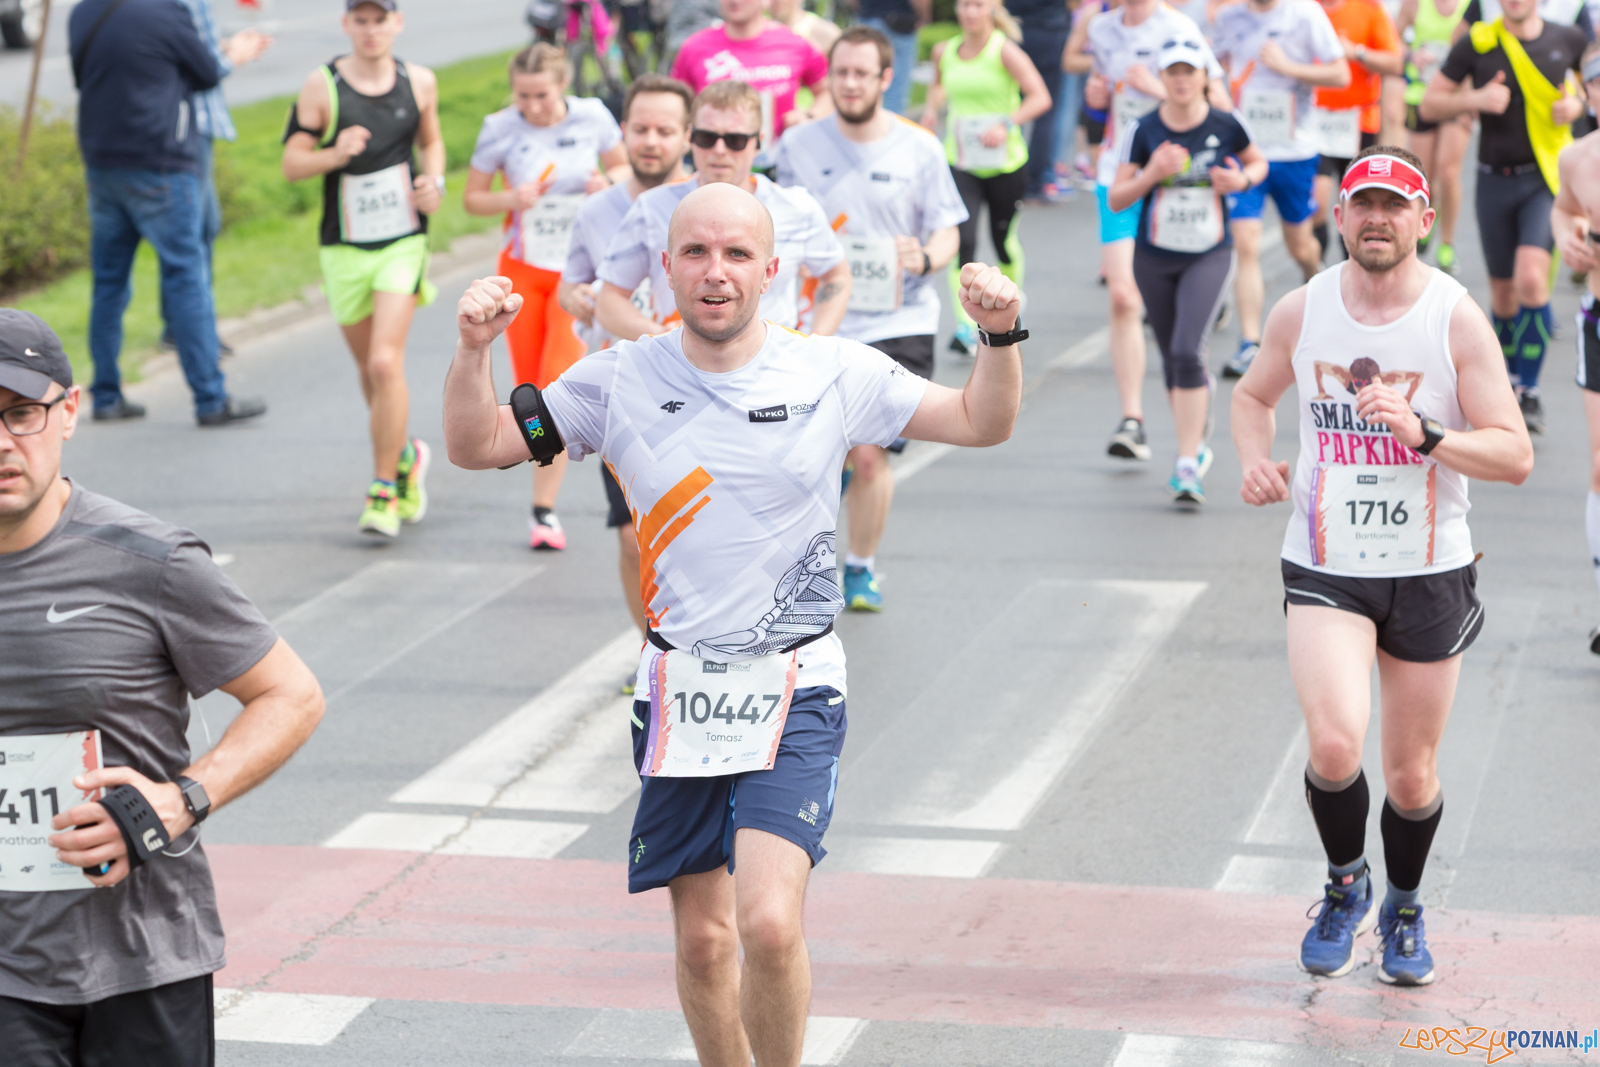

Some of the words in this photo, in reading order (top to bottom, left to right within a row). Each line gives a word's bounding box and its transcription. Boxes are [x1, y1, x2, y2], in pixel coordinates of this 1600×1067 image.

[849, 261, 889, 281] 856
[661, 401, 685, 413] 4F
[1346, 500, 1409, 525] 1716
[674, 691, 781, 725] 10447
[705, 732, 743, 742] Tomasz
